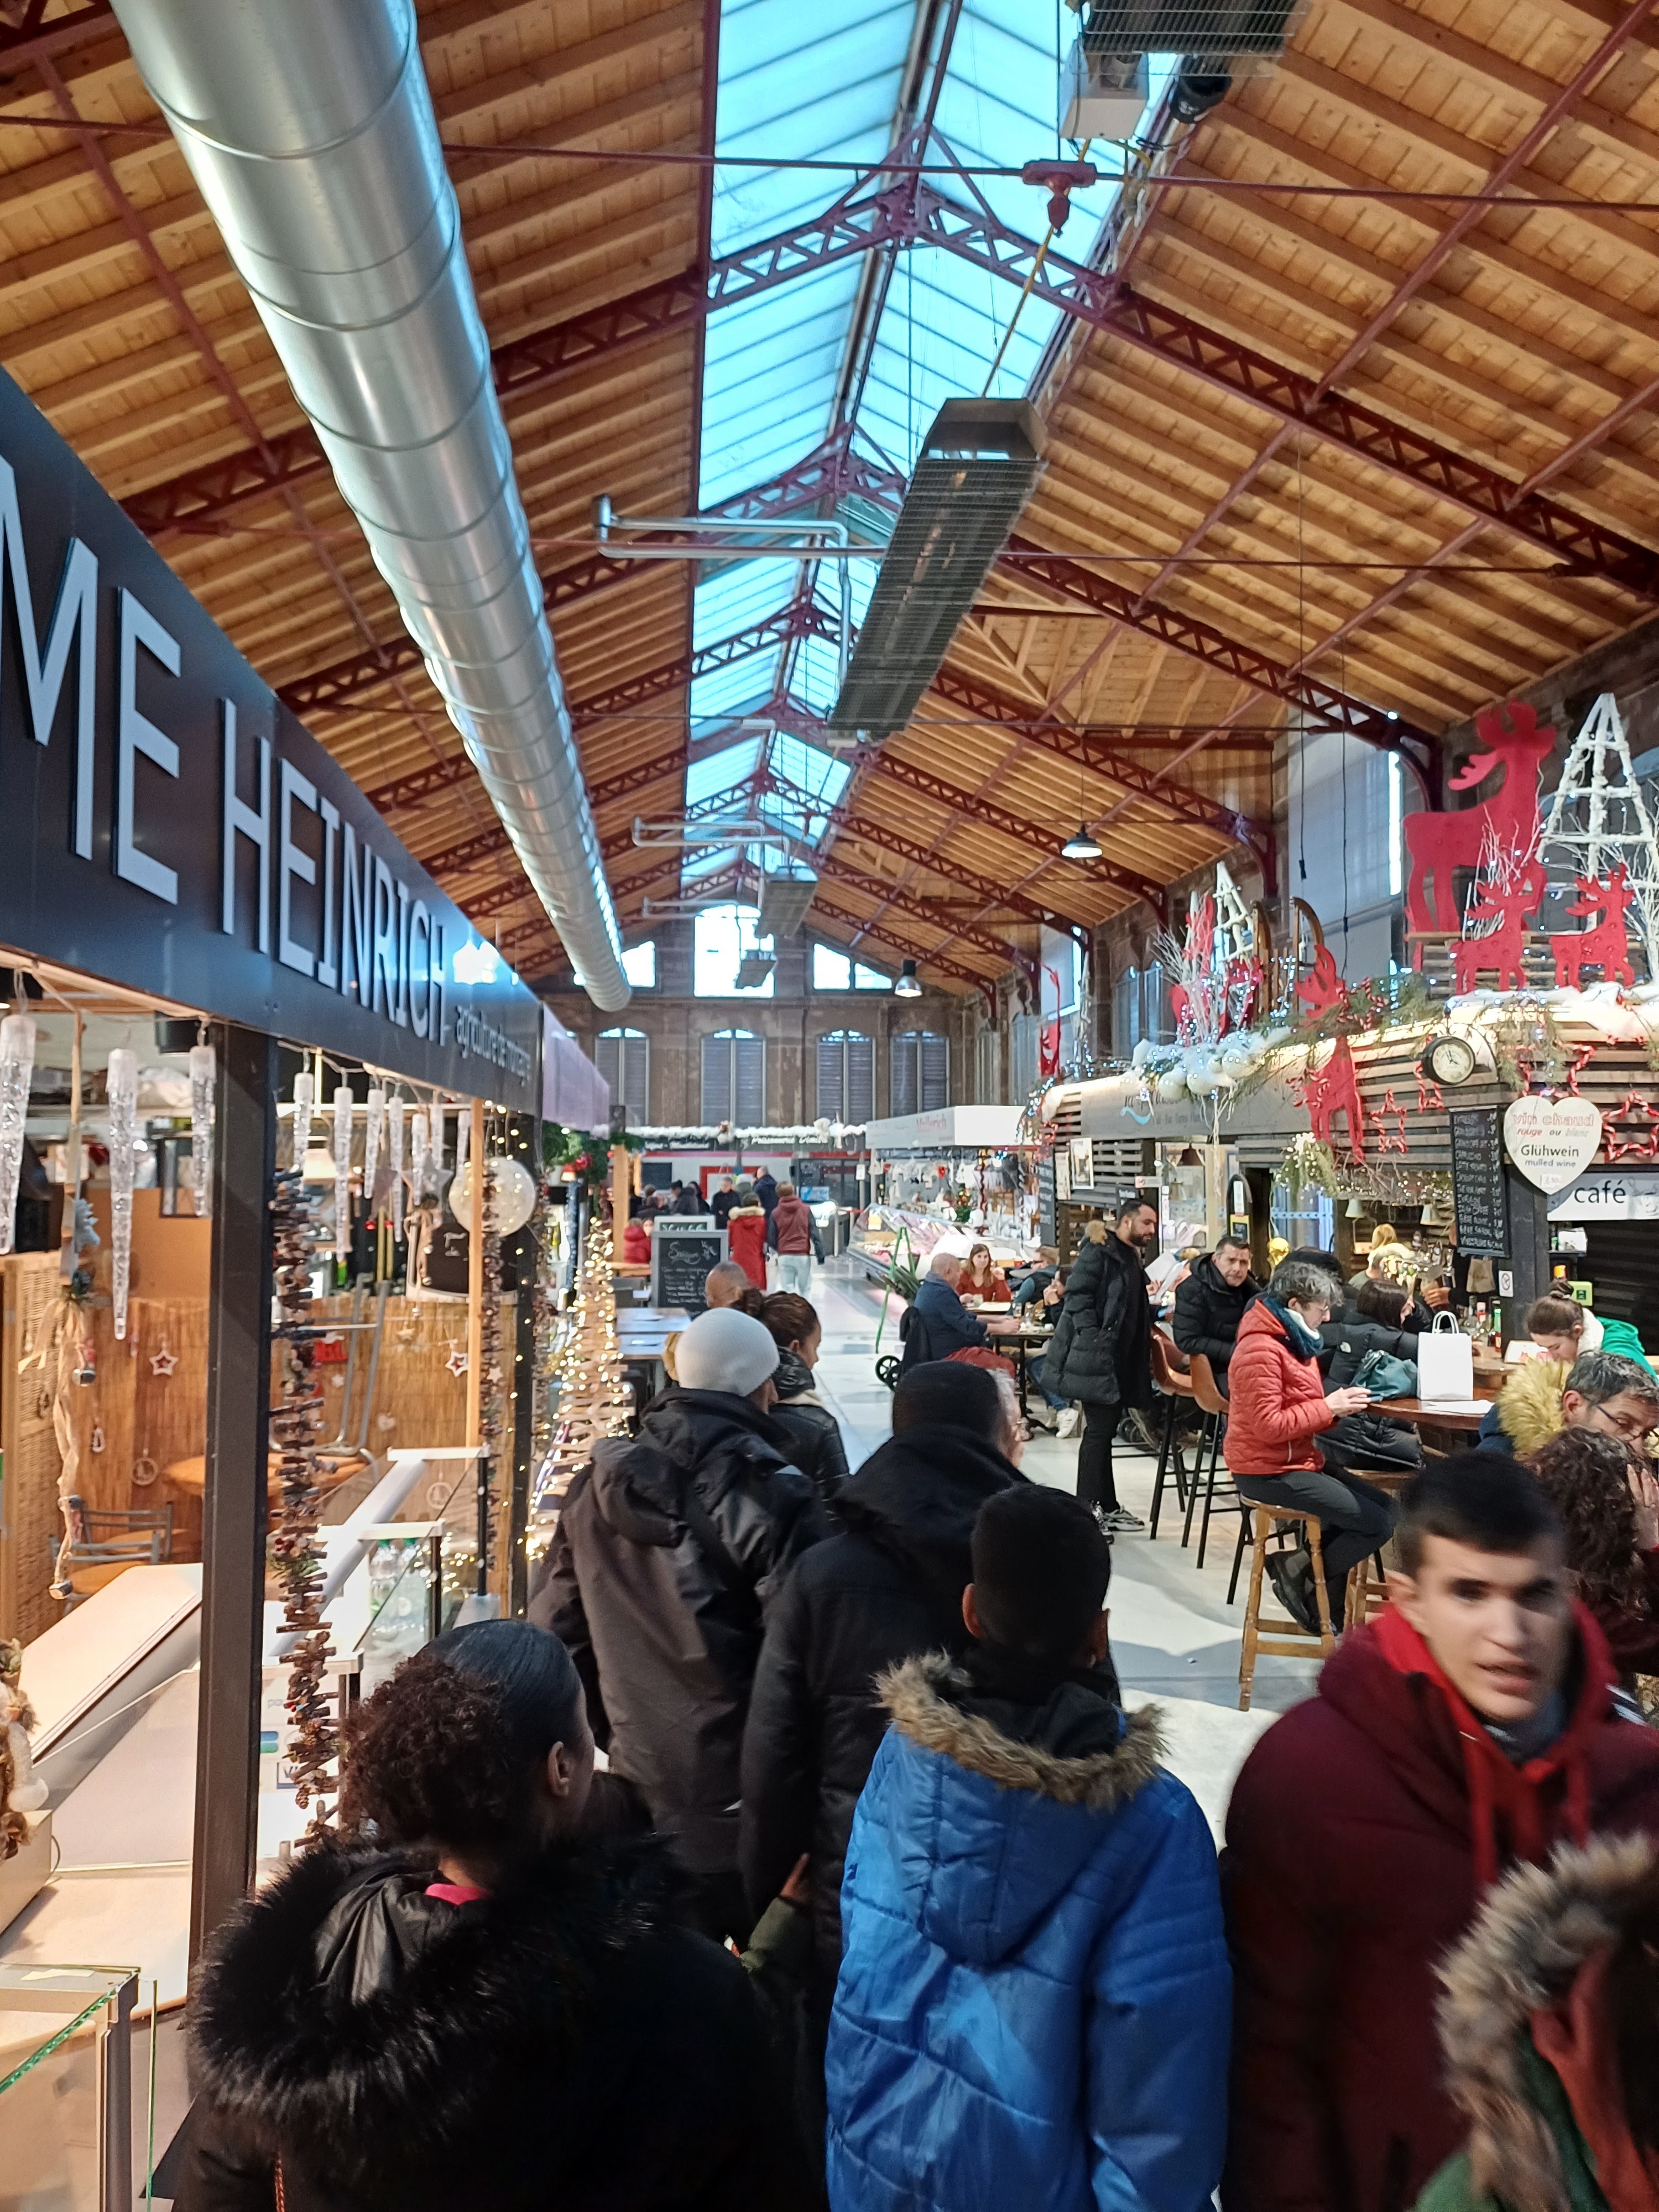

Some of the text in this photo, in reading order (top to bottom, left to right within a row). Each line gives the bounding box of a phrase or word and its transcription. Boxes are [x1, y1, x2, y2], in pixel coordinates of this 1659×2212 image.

[223, 698, 447, 1046] HEINRICH
[1513, 1113, 1537, 1125] vin
[1542, 1113, 1594, 1126] chaud
[1517, 1128, 1542, 1137] rouge
[1521, 1144, 1579, 1157] Glühwein
[1574, 1179, 1626, 1203] café
